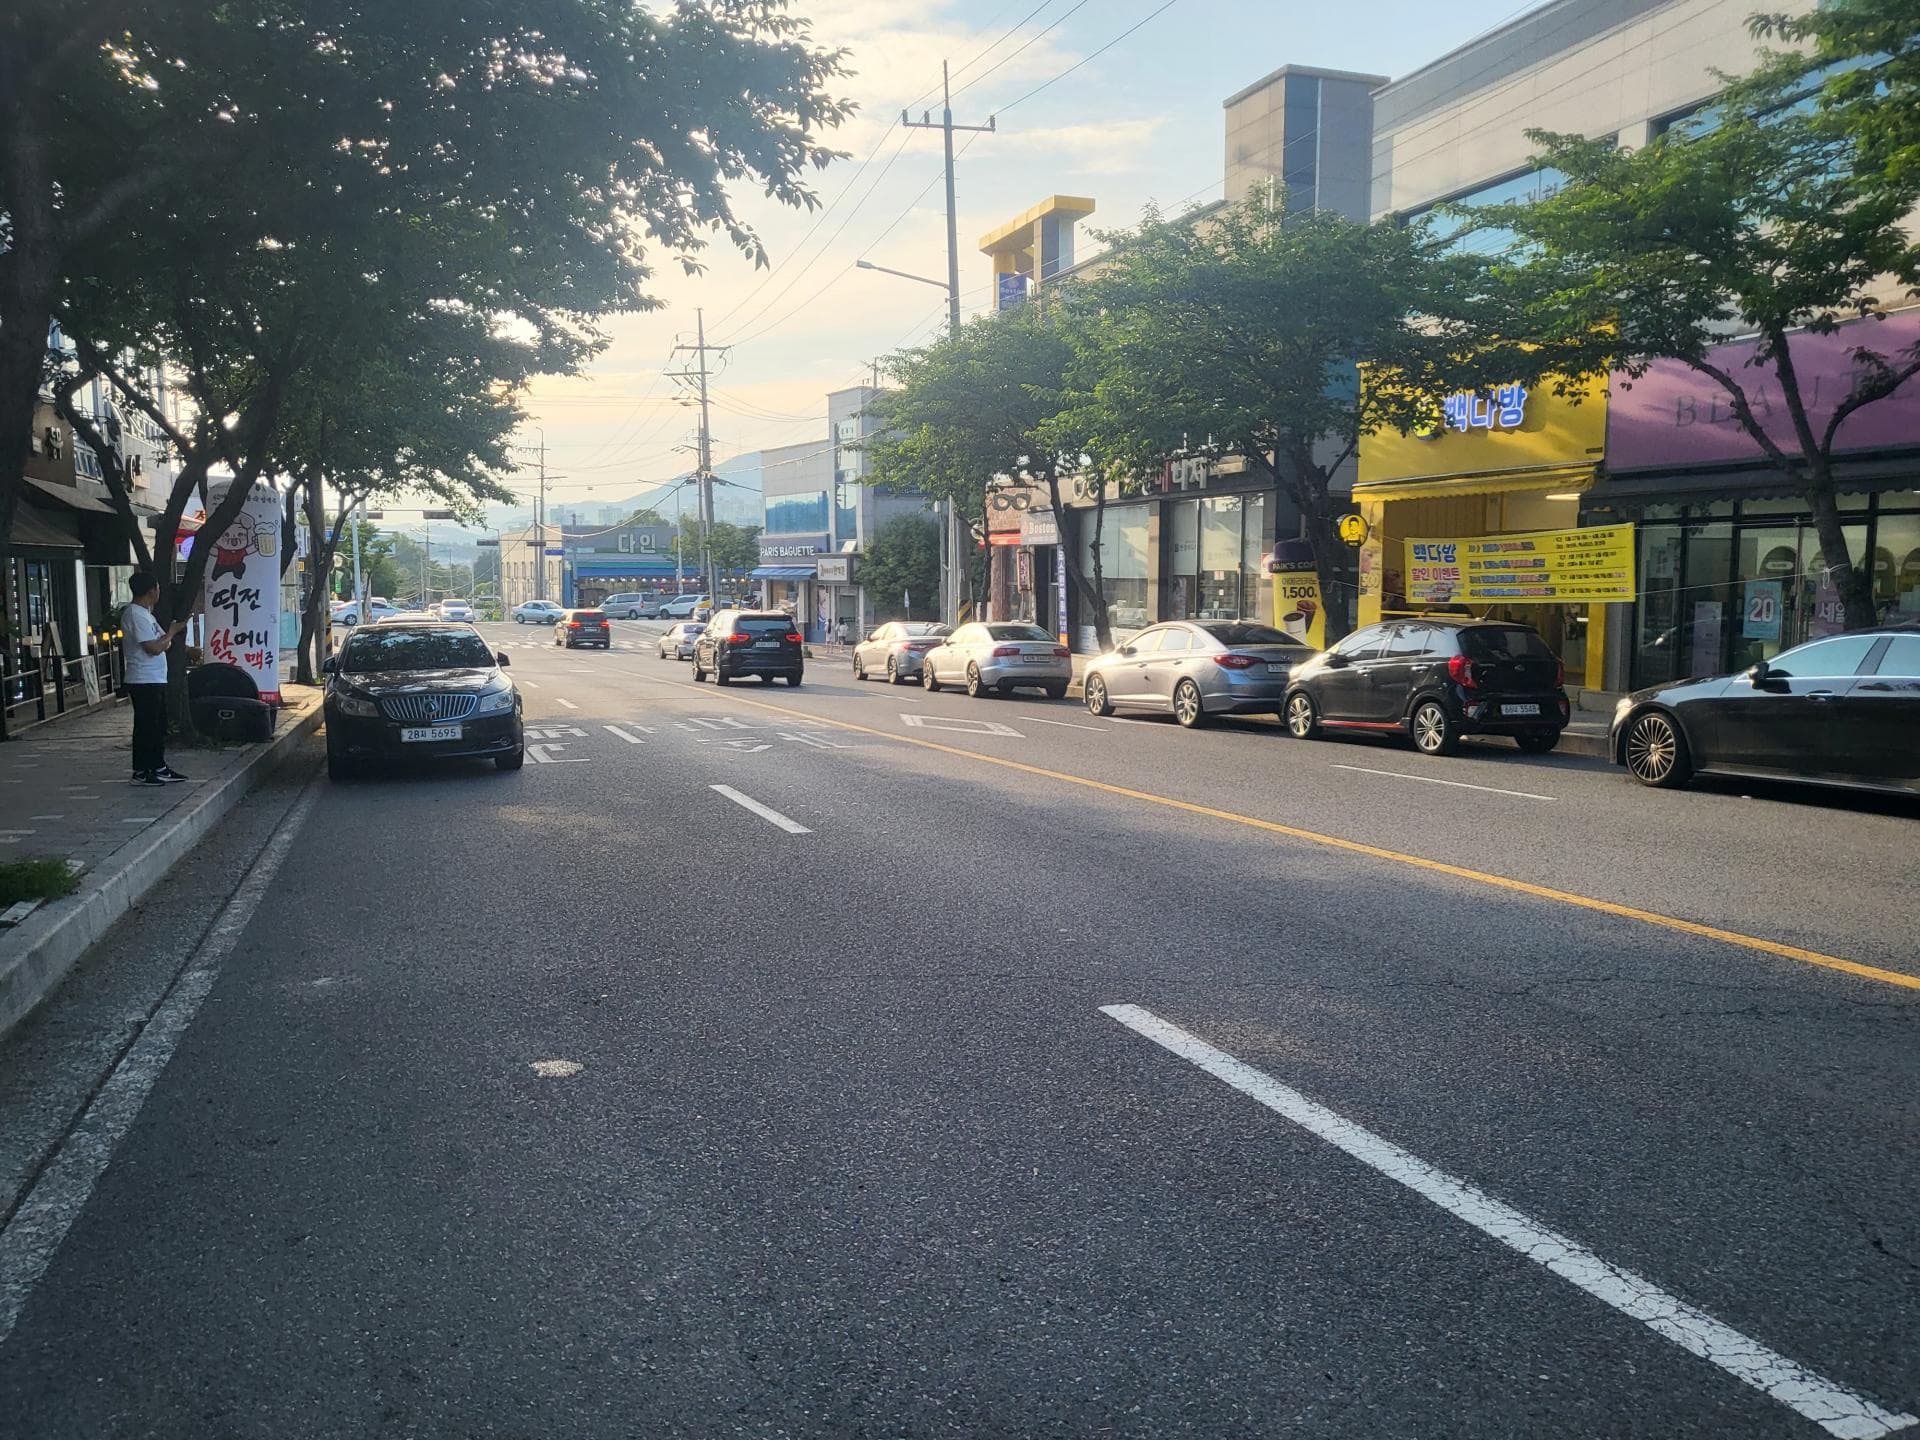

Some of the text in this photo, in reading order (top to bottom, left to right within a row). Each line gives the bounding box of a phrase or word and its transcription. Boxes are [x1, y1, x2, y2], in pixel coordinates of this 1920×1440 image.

[1443, 385, 1527, 432] 빽다방
[1028, 521, 1056, 535] Boston
[618, 534, 656, 553] 다인
[760, 545, 815, 557] PARIS BAGUETTE
[1412, 543, 1457, 563] 빽다방
[1272, 561, 1296, 570] PAIK'S
[1411, 567, 1430, 581] 할인
[1432, 567, 1461, 581] 이벤트
[1749, 596, 1775, 623] 20
[210, 628, 269, 667] 할머니
[244, 650, 274, 671] 맥주
[431, 728, 457, 738] 5695
